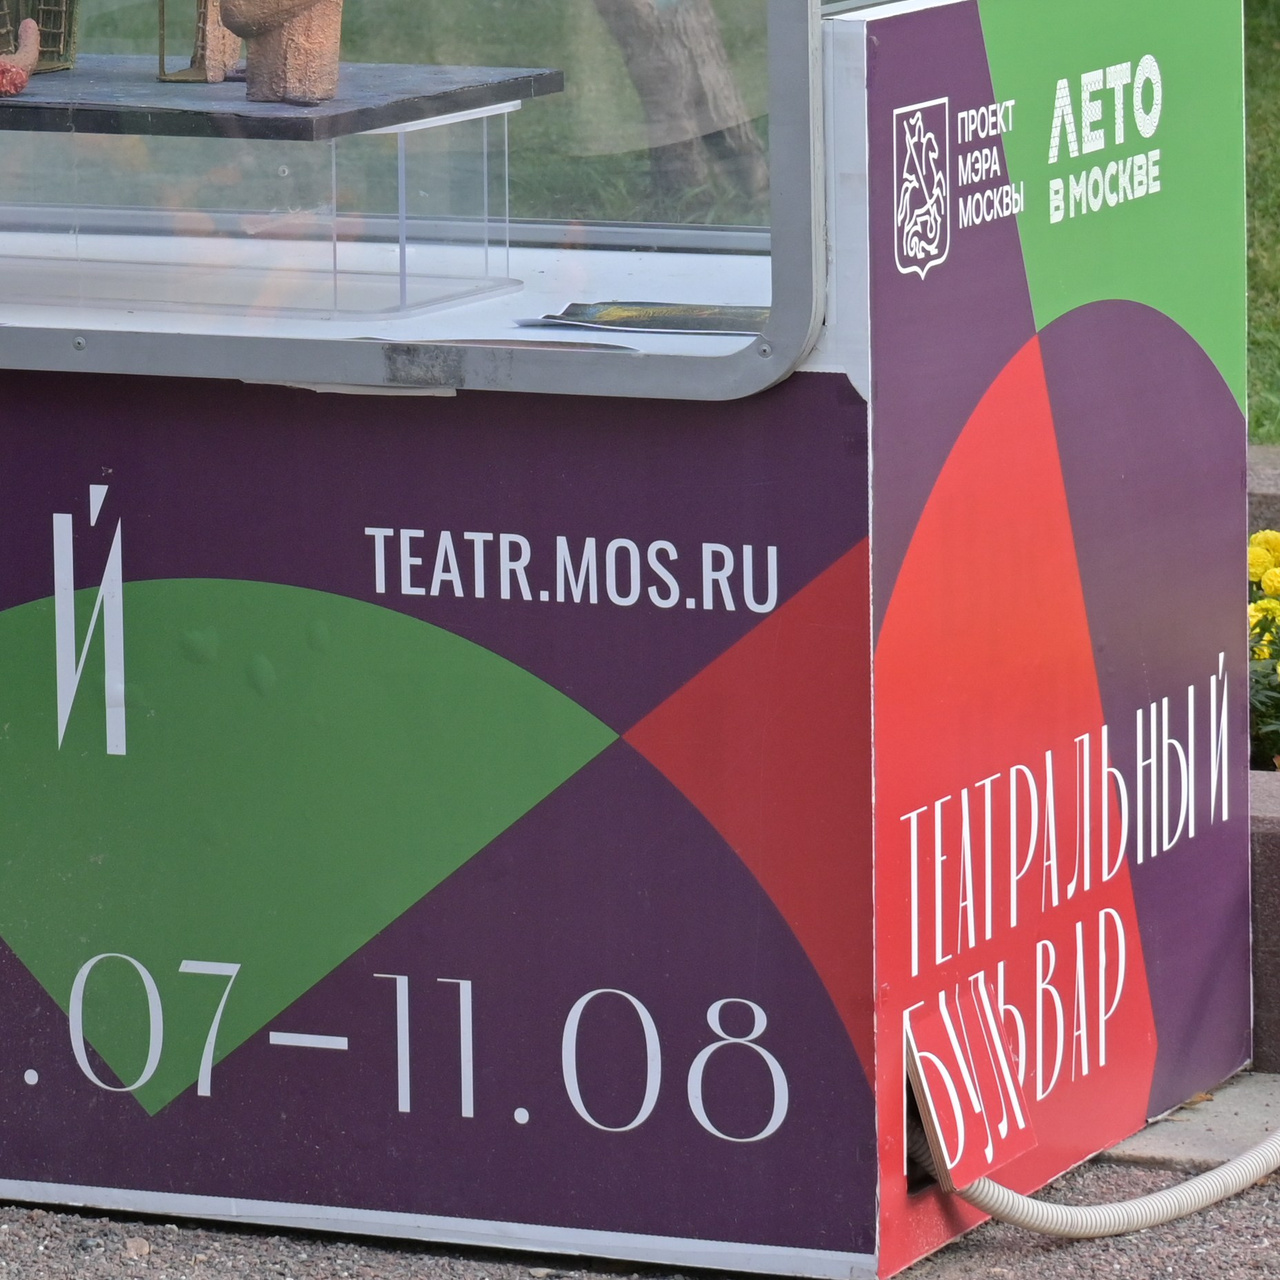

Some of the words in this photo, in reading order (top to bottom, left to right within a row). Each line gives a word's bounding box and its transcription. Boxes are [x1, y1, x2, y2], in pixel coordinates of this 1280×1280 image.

[957, 99, 1016, 144] ПРОЕКТ
[1047, 54, 1163, 165] ЛЕТО
[958, 146, 1001, 187] МЭРА
[1049, 177, 1066, 225] В
[1069, 149, 1162, 219] МОСКВЕ
[959, 181, 1025, 229] МОСКВЫ
[364, 526, 779, 614] TEATR.MOS.RU
[899, 651, 1229, 978] ТЕАТРАЛЬНЫЙ
